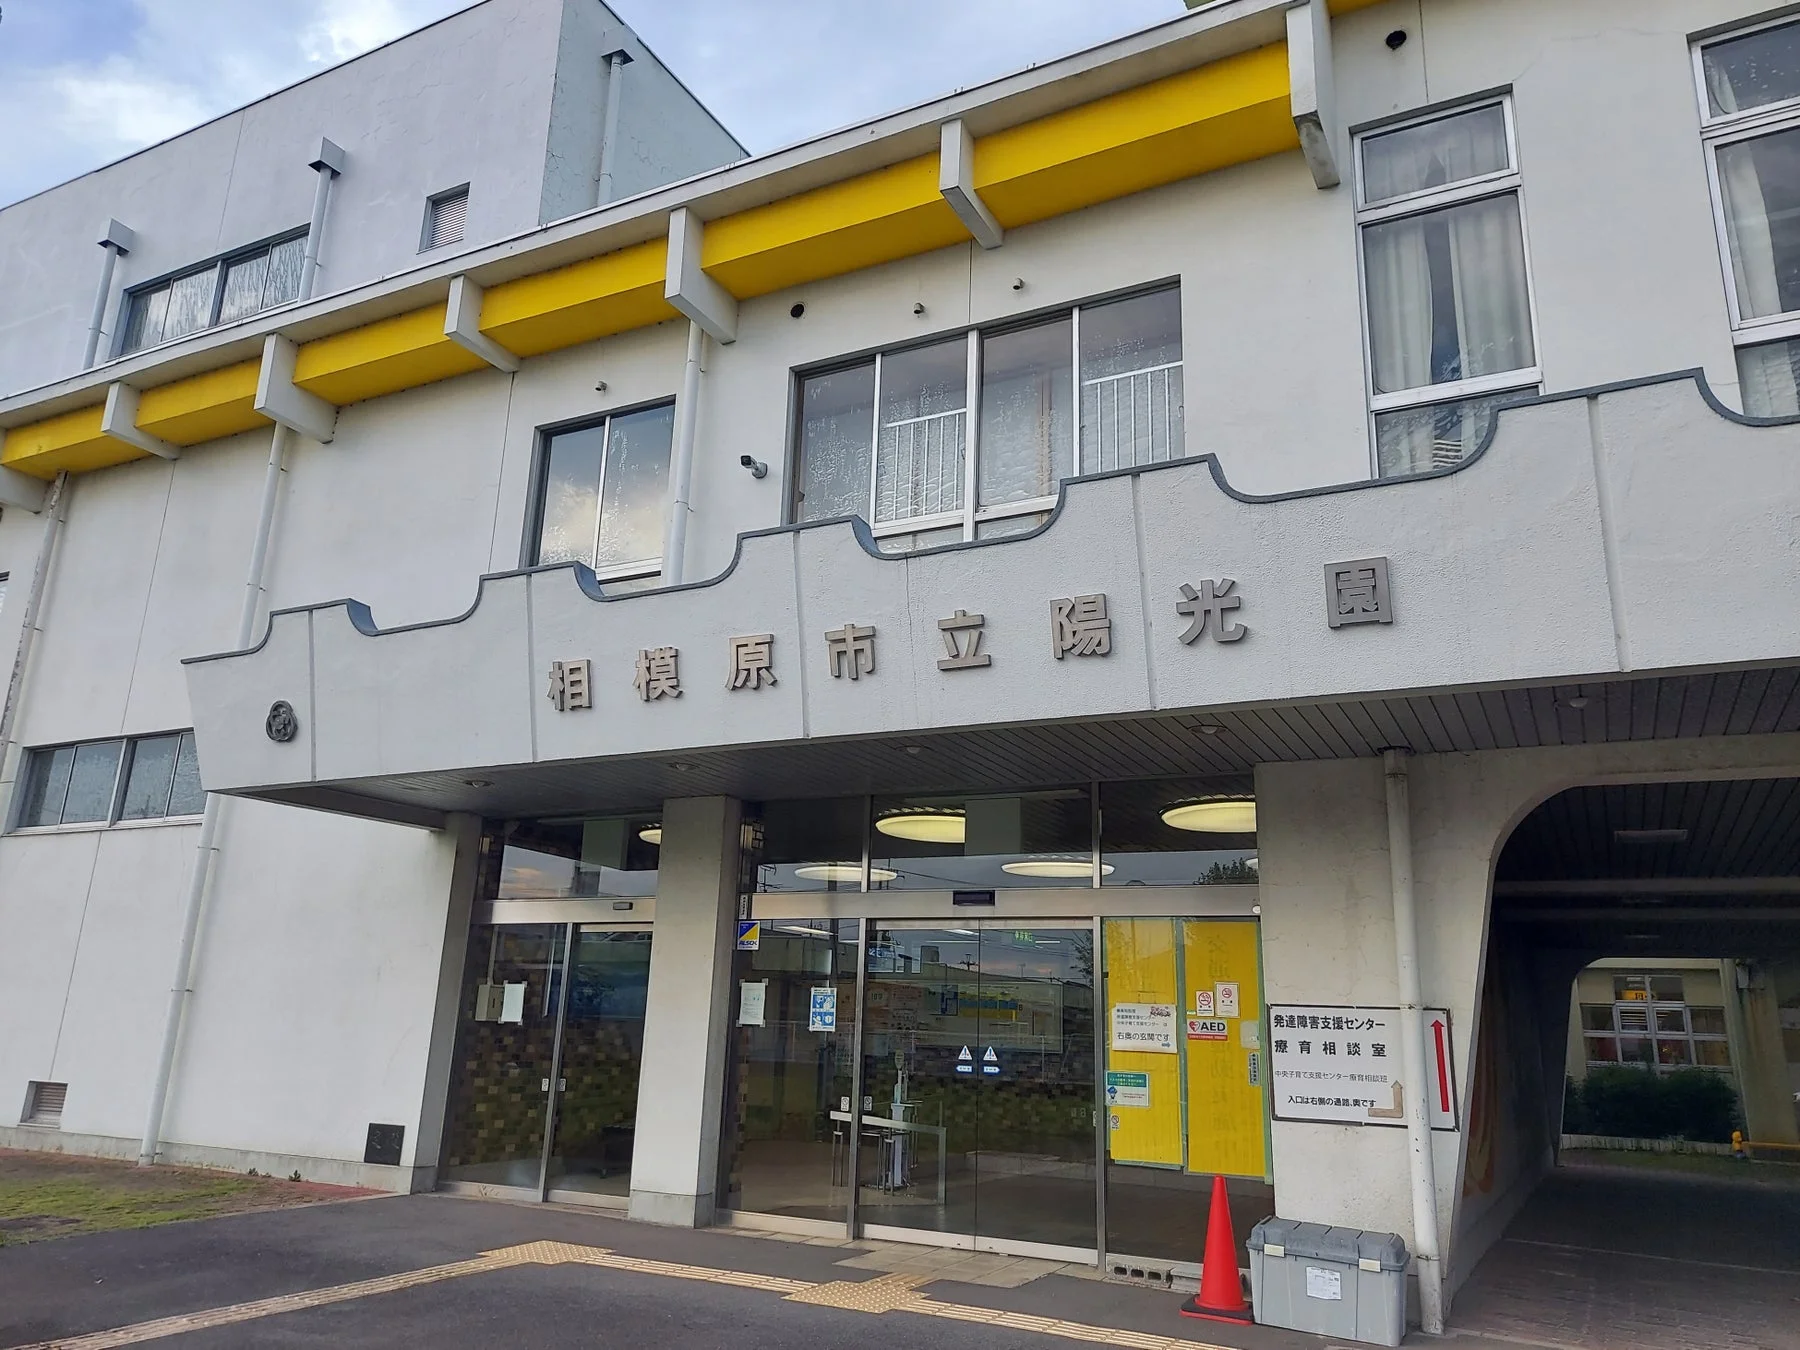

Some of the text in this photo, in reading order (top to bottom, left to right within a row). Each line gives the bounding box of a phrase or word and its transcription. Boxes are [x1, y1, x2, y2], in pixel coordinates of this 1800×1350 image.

[547, 556, 1394, 712] 相模原市立陽光園
[1200, 1021, 1226, 1032] AED
[1273, 1014, 1386, 1031] 発達障害支援センター
[1274, 1039, 1387, 1058] 療育相談室
